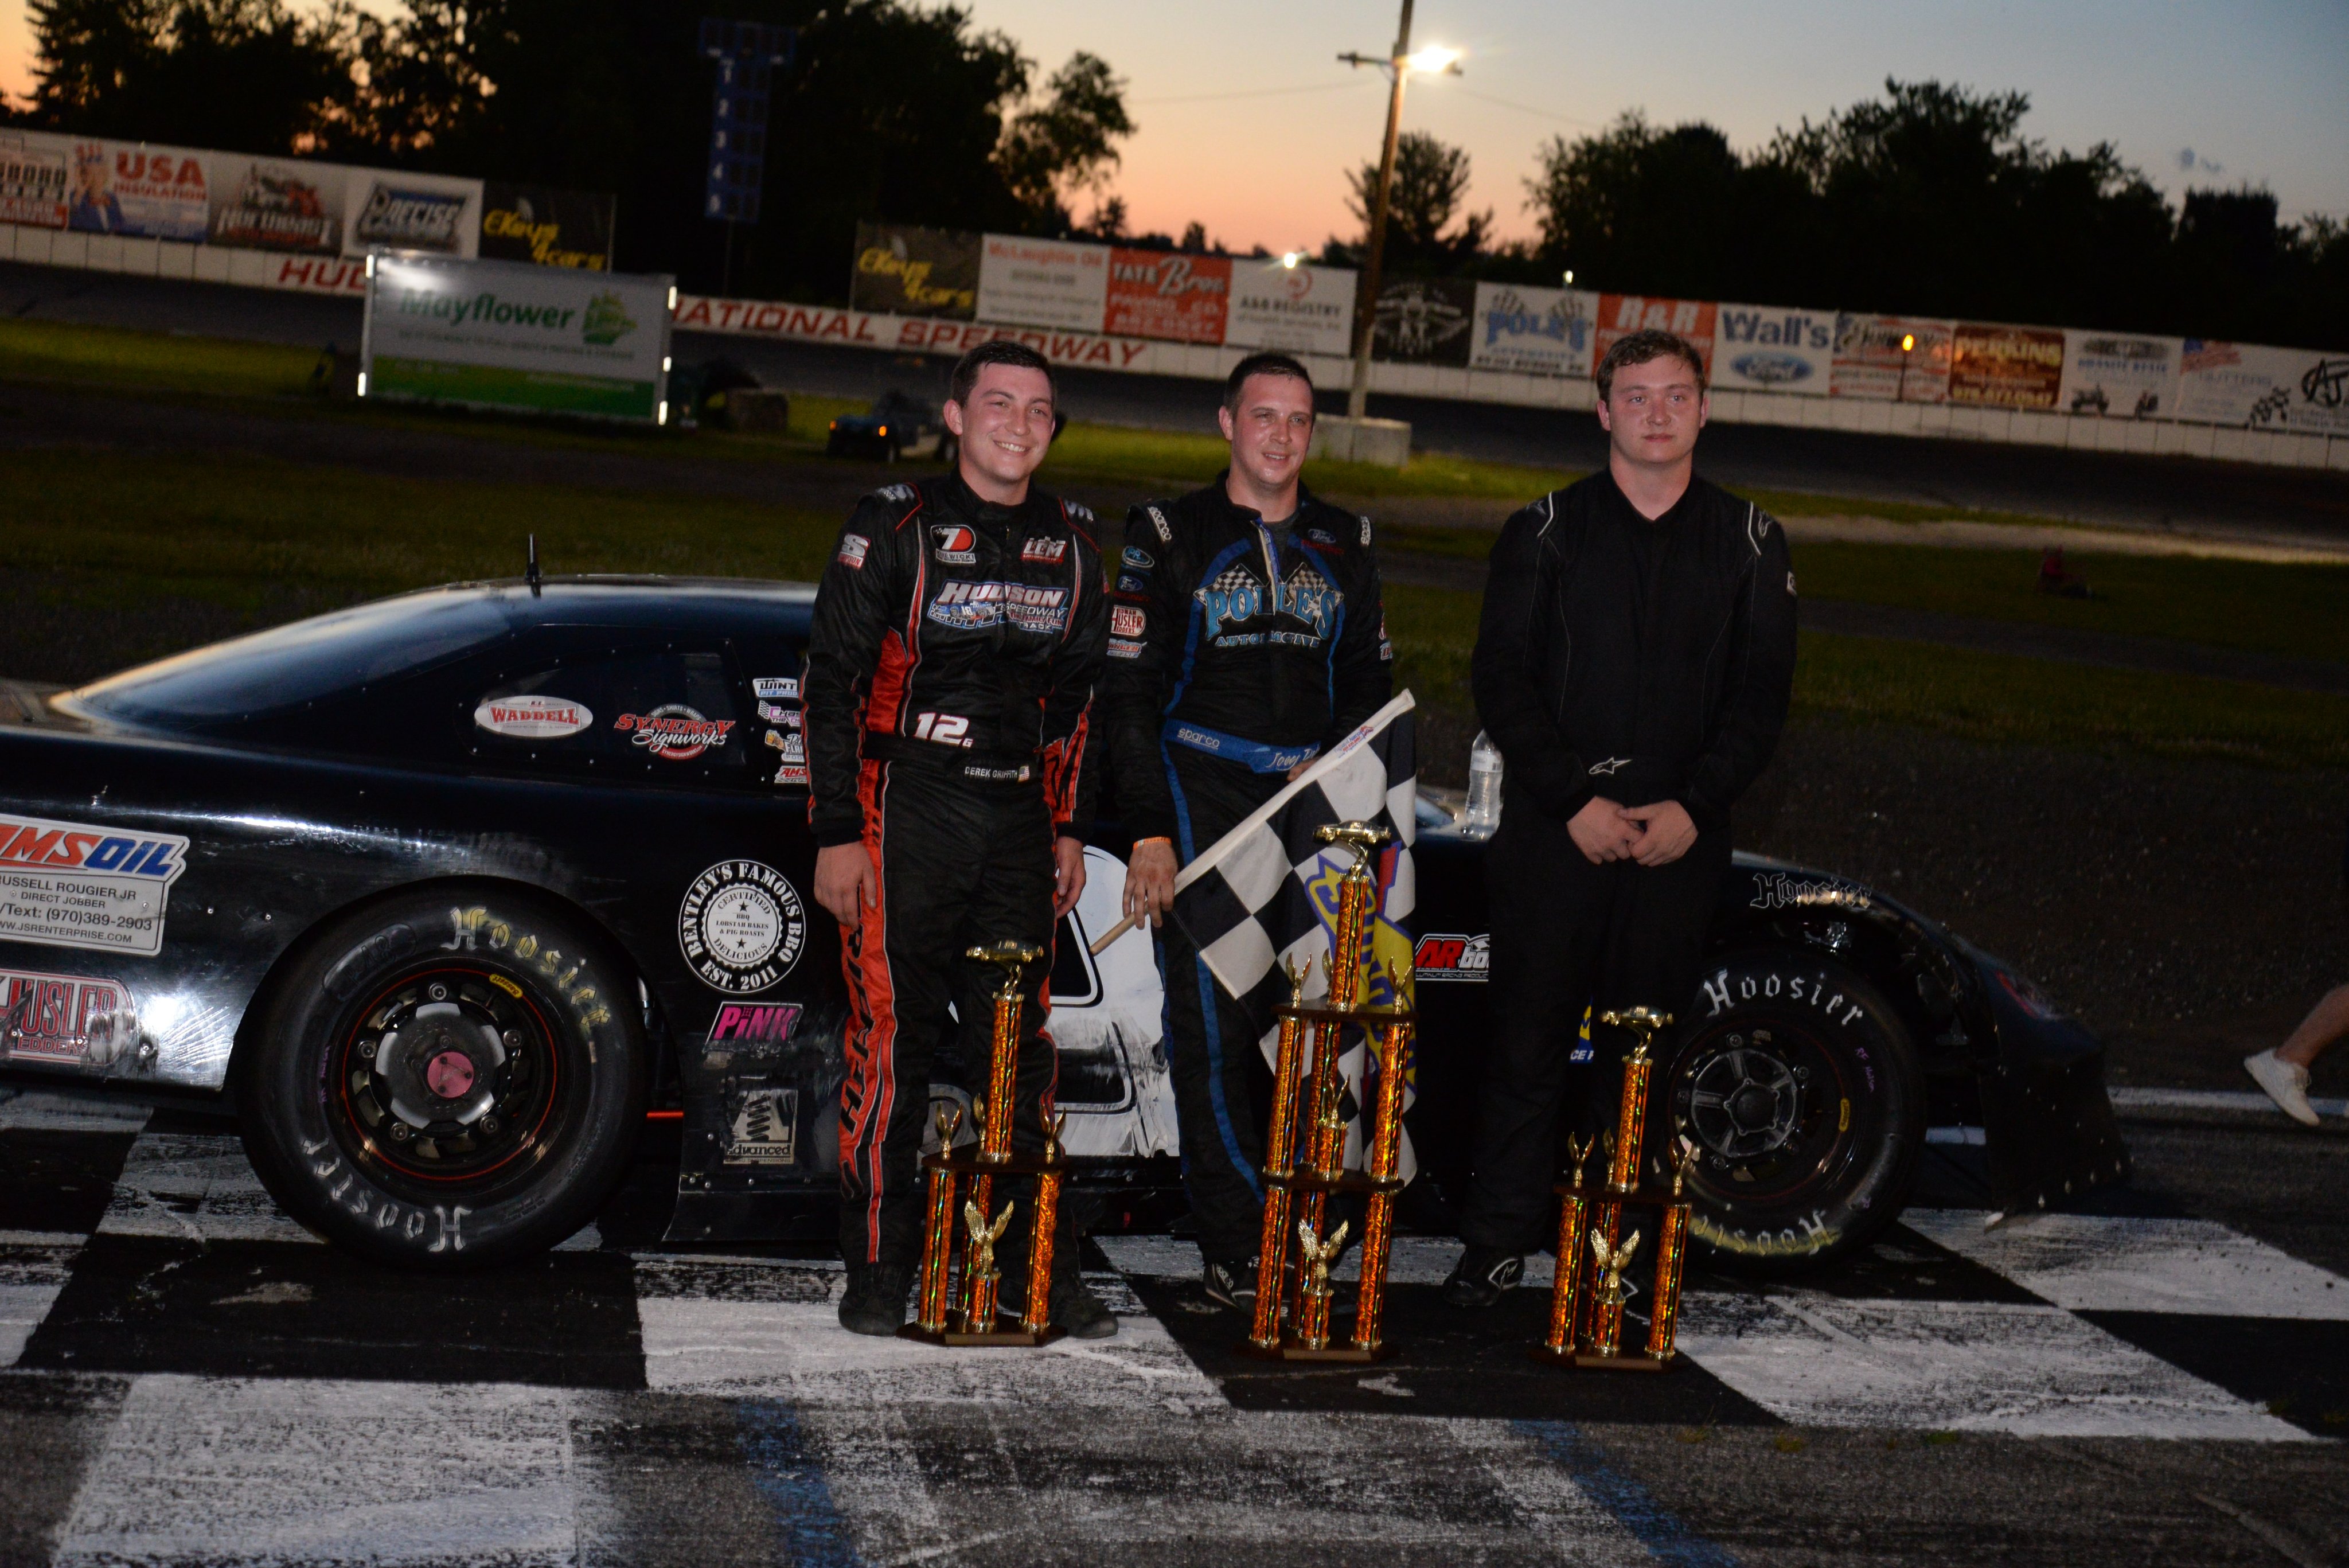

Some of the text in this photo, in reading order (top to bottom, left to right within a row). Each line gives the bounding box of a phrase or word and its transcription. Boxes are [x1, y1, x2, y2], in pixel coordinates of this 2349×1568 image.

[116, 151, 205, 189] USA
[1113, 262, 1158, 284] TATE
[400, 289, 577, 330] Mayflower
[1273, 299, 1341, 315] REGISTRY
[1617, 297, 1699, 333] R&R
[672, 297, 875, 342] ATIONAL
[1722, 311, 1829, 348] Wall's
[1954, 336, 2063, 367] PERKINS
[942, 527, 961, 551] 7
[936, 582, 1065, 608] HUDSON
[961, 605, 973, 616] 18
[1001, 602, 1068, 619] SPEEDWAY
[490, 705, 580, 726] WADDELL
[614, 713, 736, 736] SYNERGY
[631, 728, 728, 752] Signworks
[1177, 727, 1220, 751] sparco
[965, 766, 991, 778] DEREK
[1265, 751, 1301, 771] Joey
[0, 875, 136, 900] USSELL ROUGIER JR
[21, 891, 106, 908] DIRECT JOBBER
[1750, 872, 1872, 909] Hoosier
[682, 863, 802, 964] BENTLEY'S FAMOUS BBQ
[717, 892, 771, 914] CERTIFIED
[46, 907, 152, 931] (970)389-2903
[714, 938, 767, 960] DELICIOUS
[439, 907, 611, 1027] Hoosier
[700, 959, 778, 991] EST. 2011
[1703, 967, 1863, 1026] Hoosier
[14, 1035, 89, 1057] EDDERS
[302, 1138, 472, 1253] Hoosier
[1692, 1208, 1837, 1257] Hoosie
